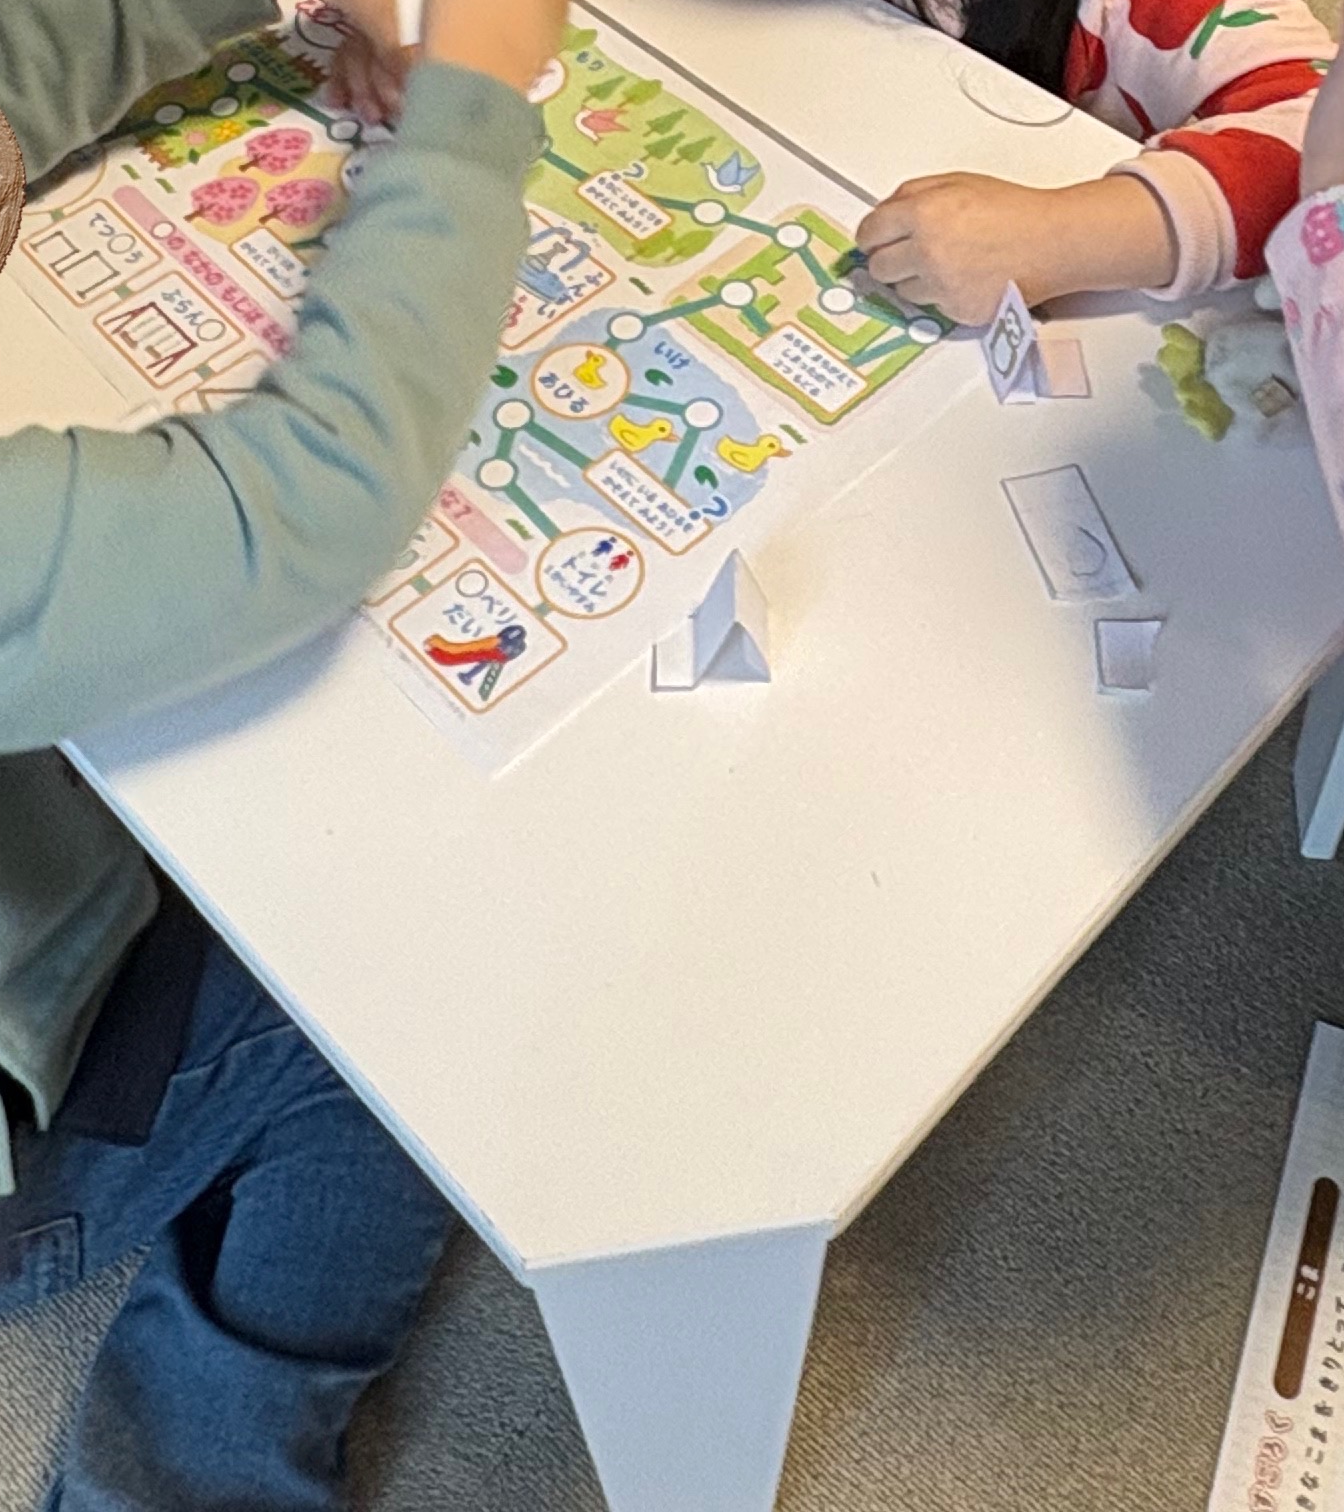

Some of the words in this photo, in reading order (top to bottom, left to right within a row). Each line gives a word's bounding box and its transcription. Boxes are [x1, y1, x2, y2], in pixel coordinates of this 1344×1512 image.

[654, 341, 690, 369] いけ
[538, 372, 590, 413] あひる
[561, 555, 608, 597] トイレ
[1297, 1264, 1321, 1301] こま
